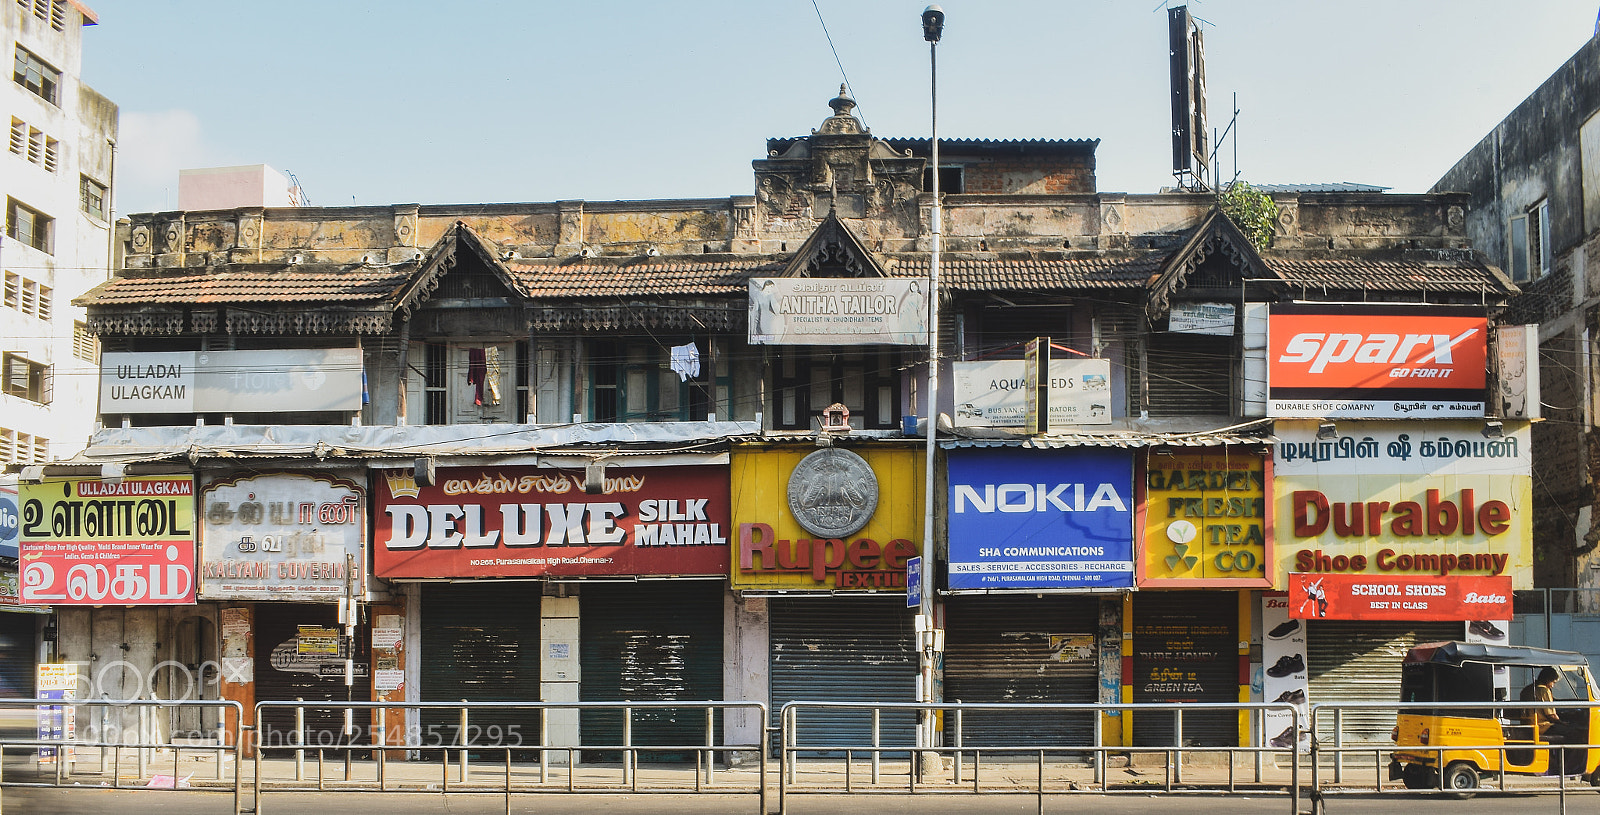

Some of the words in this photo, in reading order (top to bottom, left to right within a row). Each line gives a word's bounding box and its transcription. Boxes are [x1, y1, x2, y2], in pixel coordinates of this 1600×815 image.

[779, 295, 838, 315] ANITHA
[841, 295, 897, 315] TAILOR
[117, 364, 182, 379] ULLADAI
[1389, 367, 1407, 378] GO
[1409, 367, 1437, 378] FOR
[1438, 367, 1454, 378] IT
[111, 384, 186, 400] ULAGKAM
[1275, 403, 1310, 411] DURABLE
[1312, 403, 1334, 411] SHOE
[1335, 403, 1376, 411] COMAPNY
[1149, 470, 1265, 490] GARDEN
[79, 482, 129, 496] ULLADAI
[131, 482, 191, 495] ULAGKAM
[954, 483, 1128, 514] NOKIA
[1167, 497, 1265, 517] FRESH
[23, 481, 191, 537] உள்ளாடை
[638, 499, 709, 523] SILK
[1293, 488, 1511, 538] Durable
[385, 502, 627, 549] DELUXE
[634, 523, 727, 547] MAHAL
[1206, 524, 1265, 545] TEA
[739, 522, 917, 581] Rupee
[979, 547, 1001, 557] SHA
[1003, 546, 1105, 557] COMMUNICATIONS
[205, 561, 271, 579] KALYANI
[547, 557, 561, 567] High
[956, 564, 981, 572] SALES
[1025, 563, 1079, 571] ACCESSORIES
[1084, 562, 1126, 571] RECHARGE
[1296, 549, 1368, 573] Shoe
[1376, 549, 1509, 576] Company
[23, 545, 192, 601] உலகம்
[834, 571, 908, 588] TEXTIL
[1351, 584, 1402, 596] SCHOOL
[1405, 584, 1447, 596] SHOES
[1463, 592, 1507, 605] Bata
[1265, 599, 1290, 609] Ba
[1370, 602, 1389, 610] BEST
[1391, 602, 1401, 610] IN
[1402, 601, 1428, 610] CLASS
[1144, 683, 1181, 693] GREEN
[1182, 683, 1204, 693] TEA
